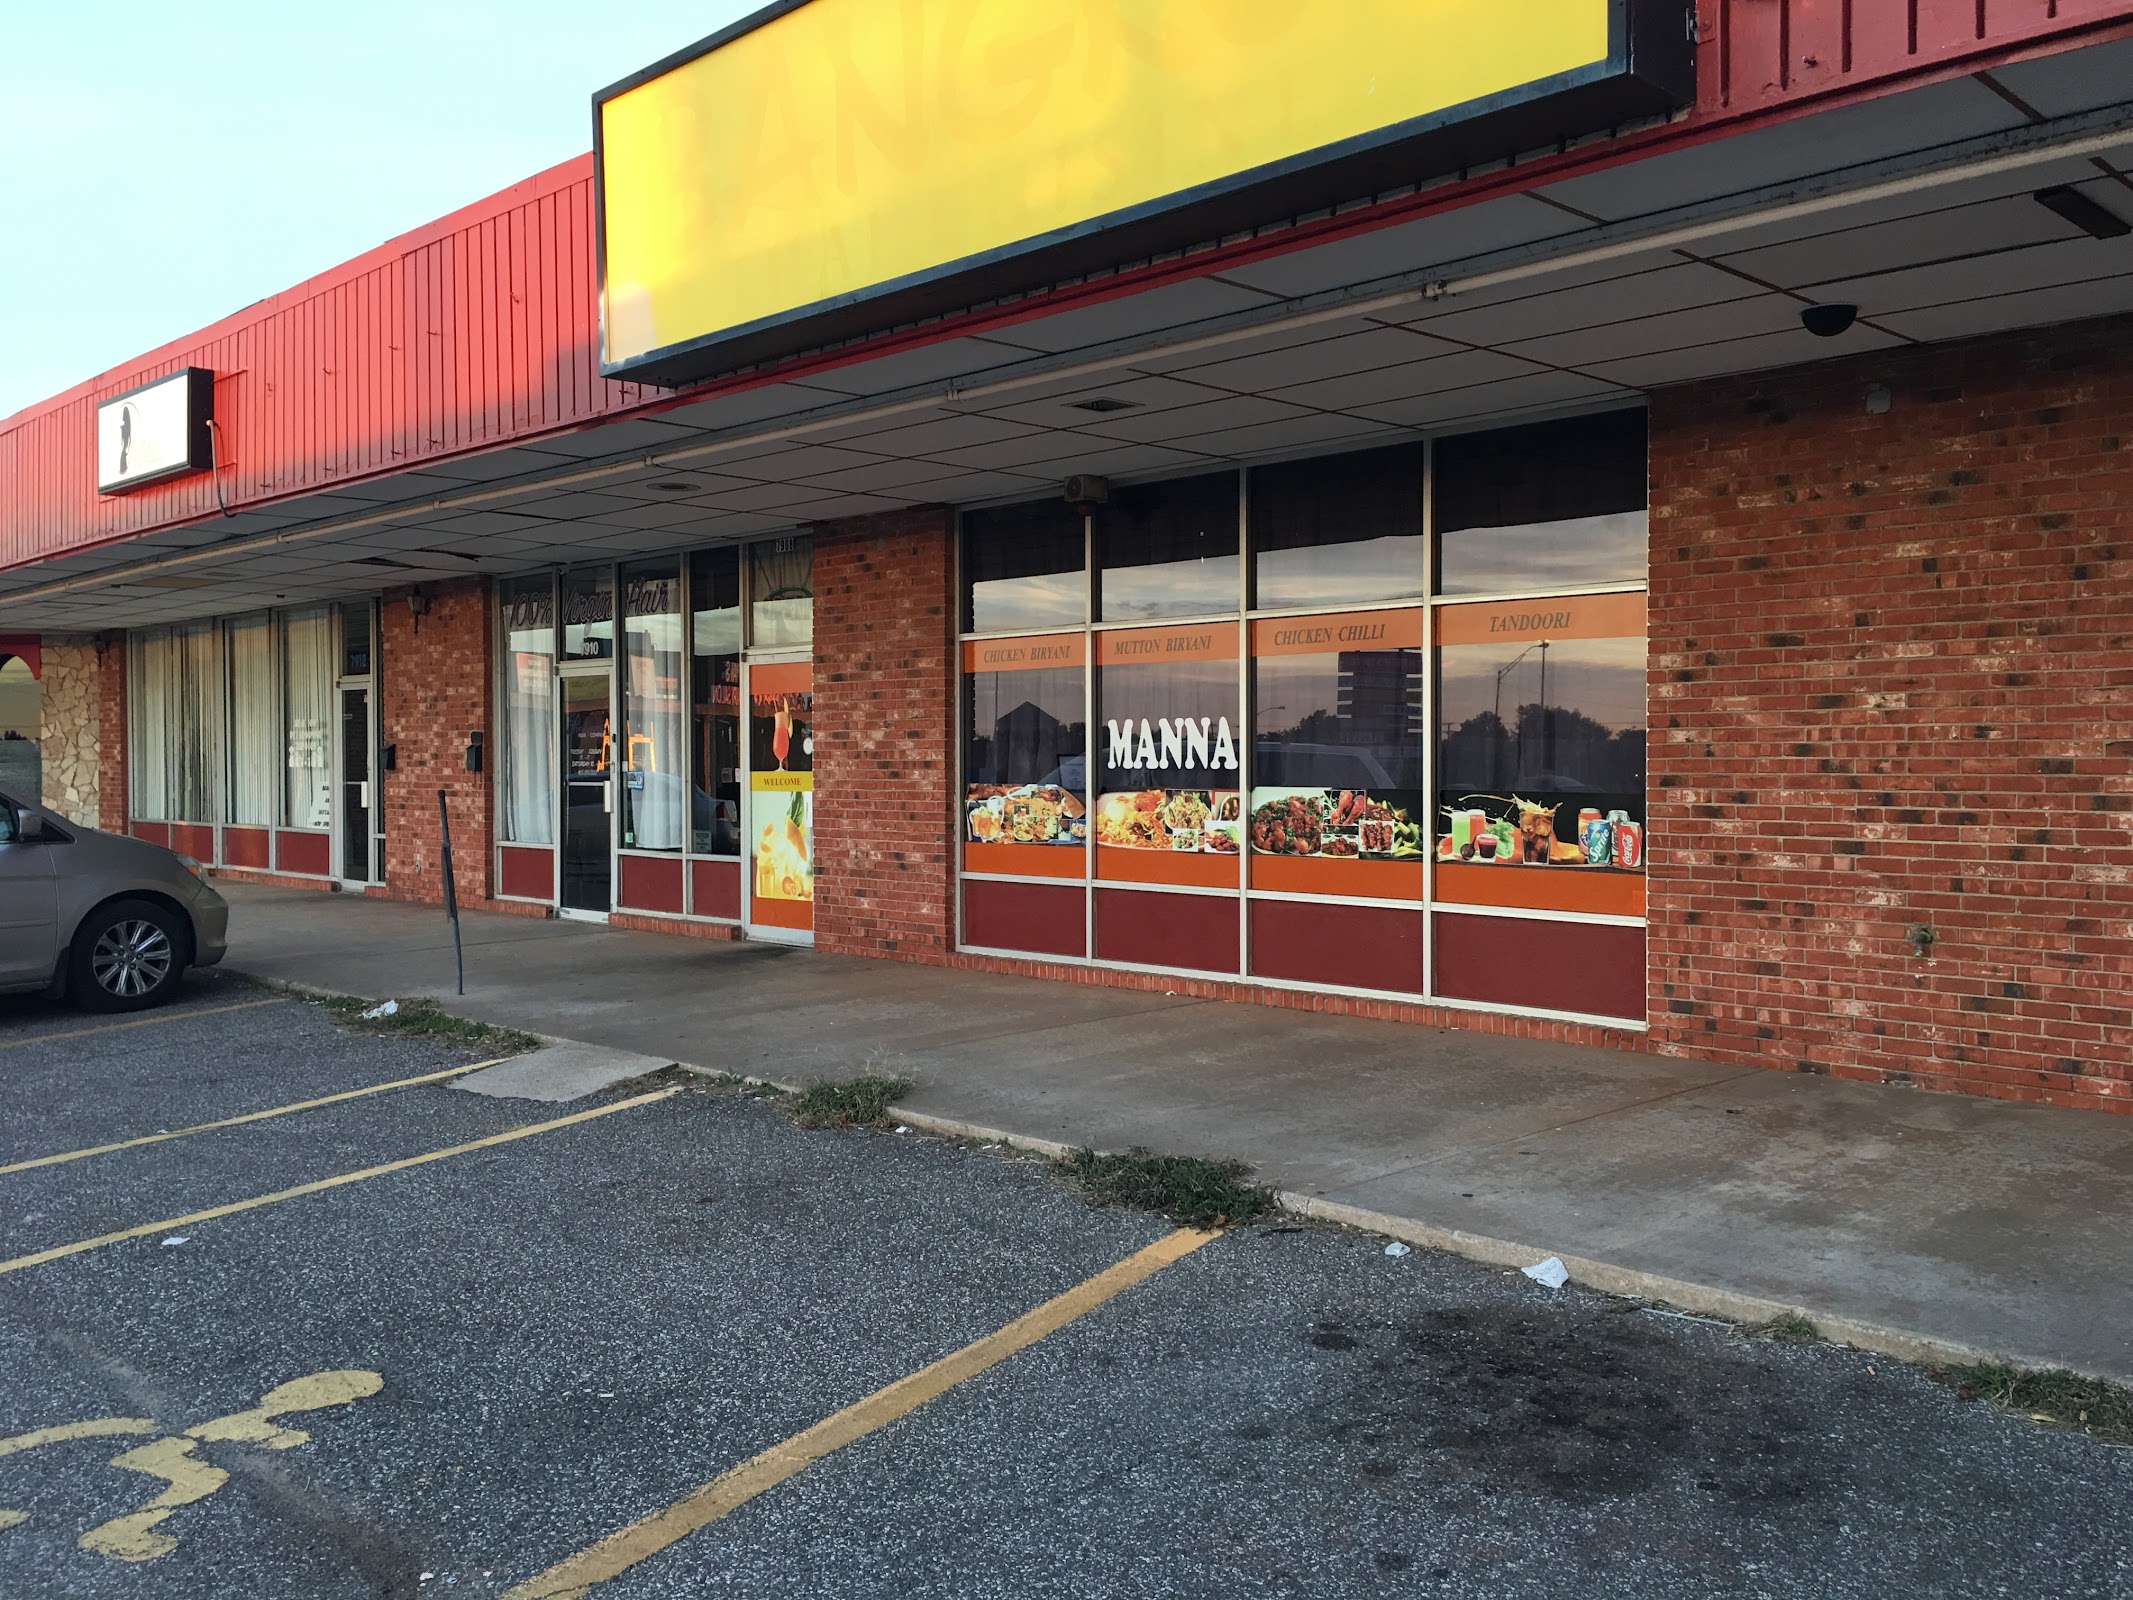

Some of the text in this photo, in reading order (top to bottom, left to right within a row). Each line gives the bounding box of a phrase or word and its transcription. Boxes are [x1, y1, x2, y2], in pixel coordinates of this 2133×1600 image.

[510, 577, 669, 634] 100% Virgin Hair
[1489, 611, 1573, 633] TANDOORI
[1114, 635, 1213, 655] MUTTON BIRYANI
[1274, 623, 1386, 646] CHICKEN CHILLI
[580, 641, 599, 656] 7910
[983, 645, 1071, 664] CHICKEN BIRYANI
[1107, 716, 1239, 770] MANNA
[763, 777, 802, 787] WELCOME
[1589, 829, 1610, 862] Sprite
